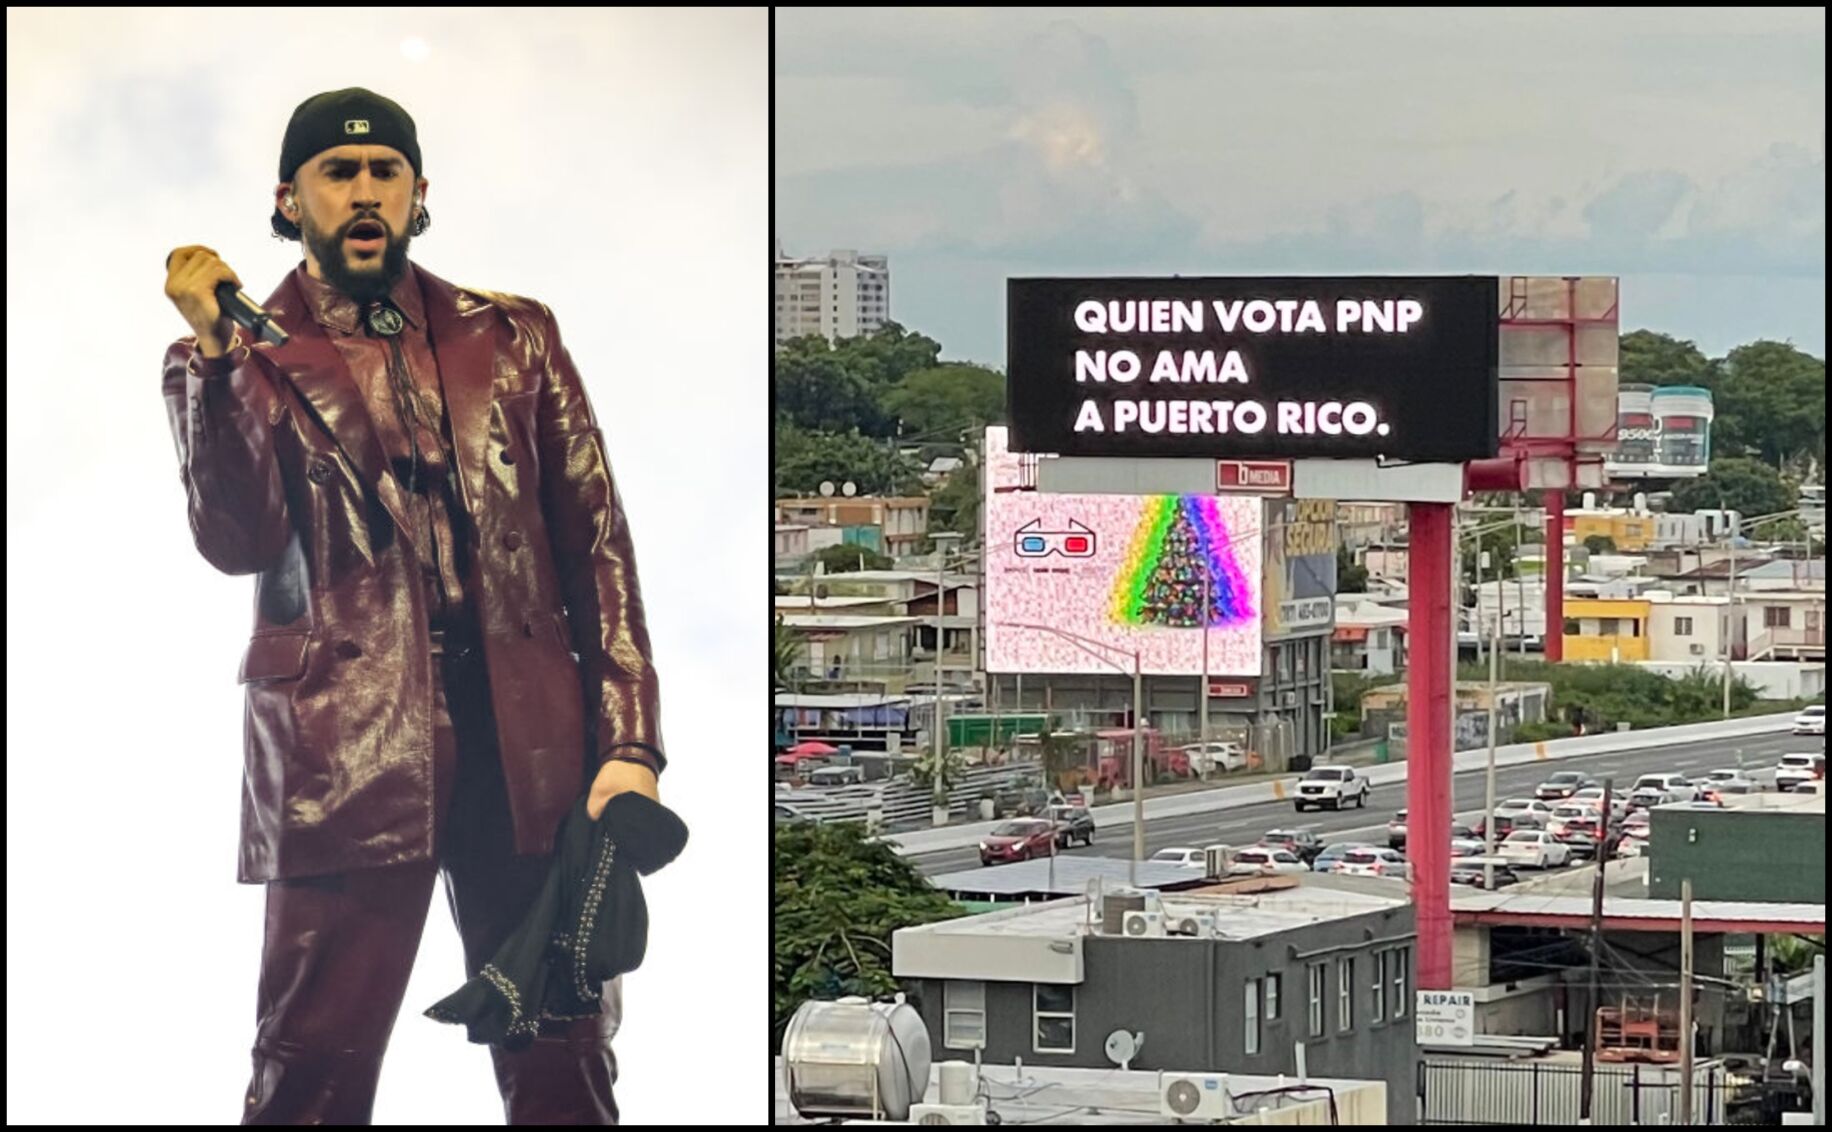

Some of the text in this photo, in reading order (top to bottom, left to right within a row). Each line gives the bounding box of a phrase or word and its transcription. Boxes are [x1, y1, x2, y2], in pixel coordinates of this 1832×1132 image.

[1074, 300, 1423, 333] QUIEN VOTA PNP
[1075, 350, 1248, 383] NO AMA
[1074, 400, 1390, 436] A PUERTO RICO.
[1423, 994, 1471, 1007] REPAIR
